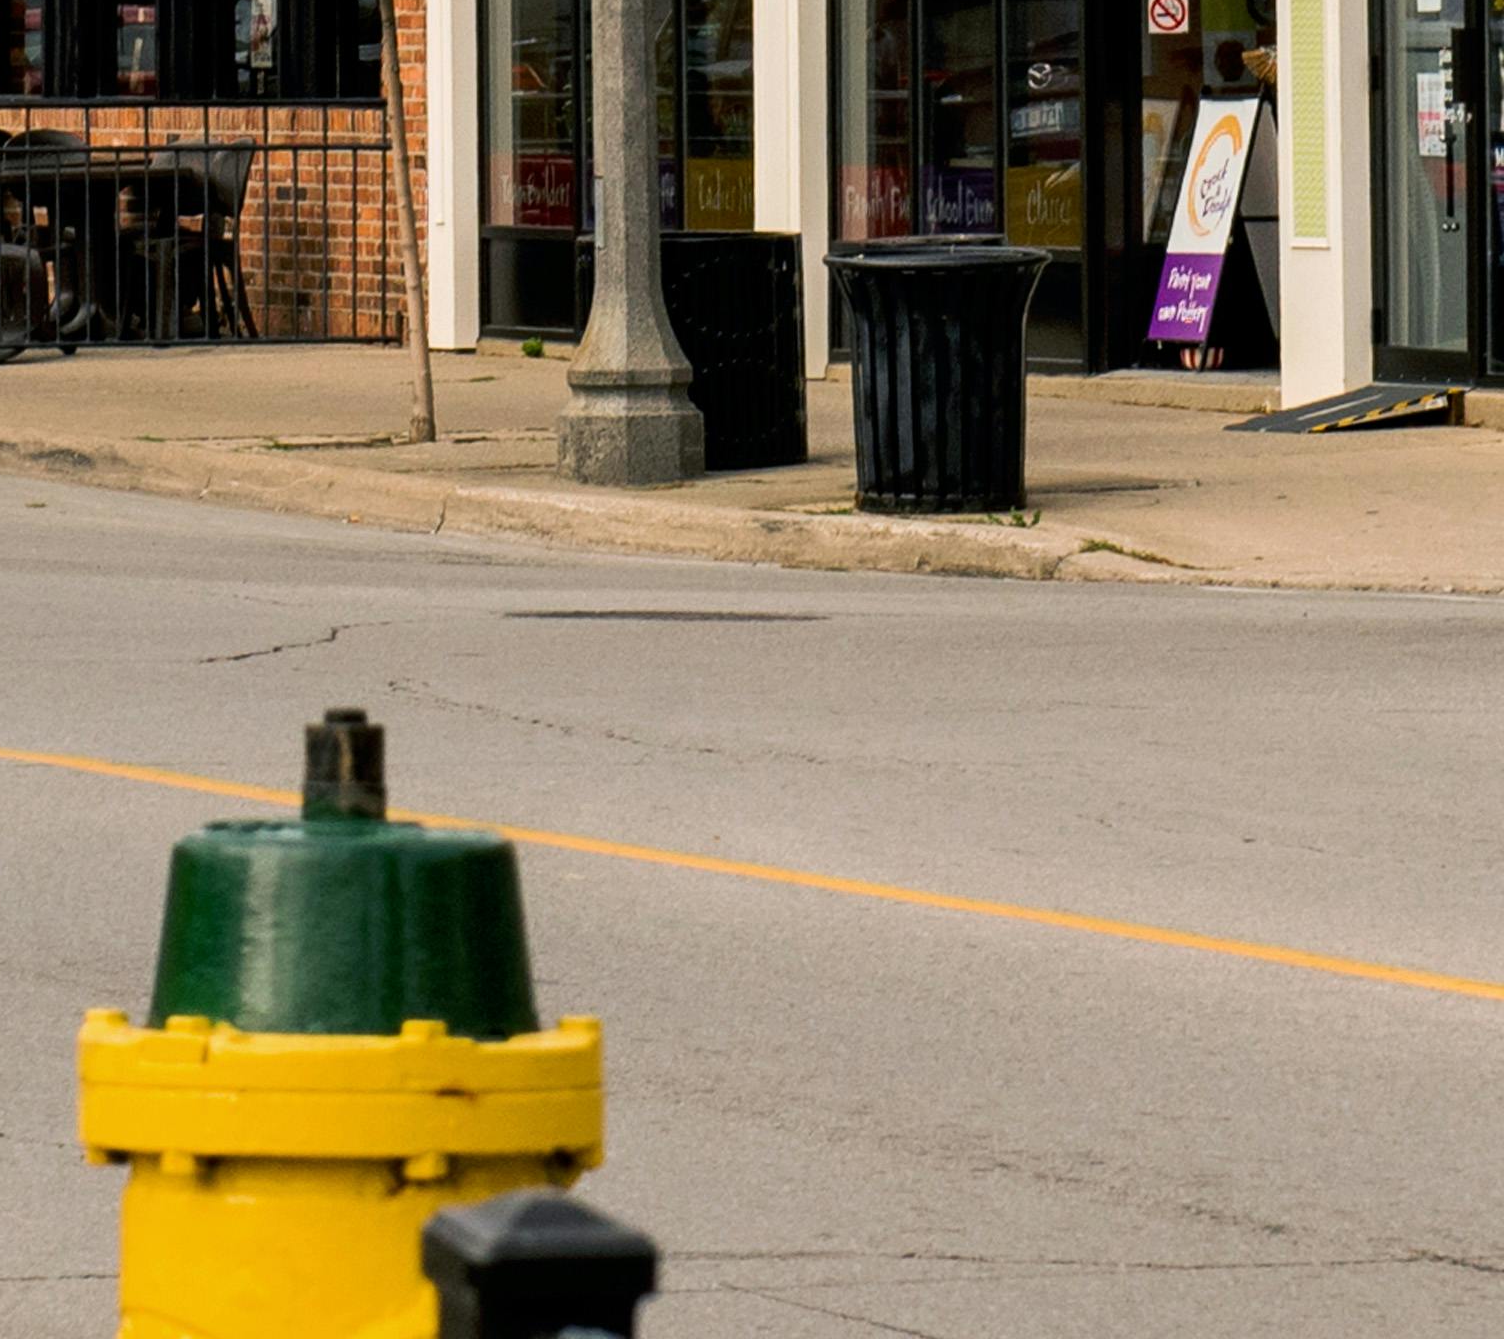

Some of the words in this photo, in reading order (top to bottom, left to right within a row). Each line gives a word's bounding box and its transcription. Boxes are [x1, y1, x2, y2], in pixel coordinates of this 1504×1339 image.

[1167, 266, 1191, 290] Paint
[1189, 269, 1212, 301] your
[1158, 305, 1177, 322] own
[1176, 300, 1208, 333] Pottery
